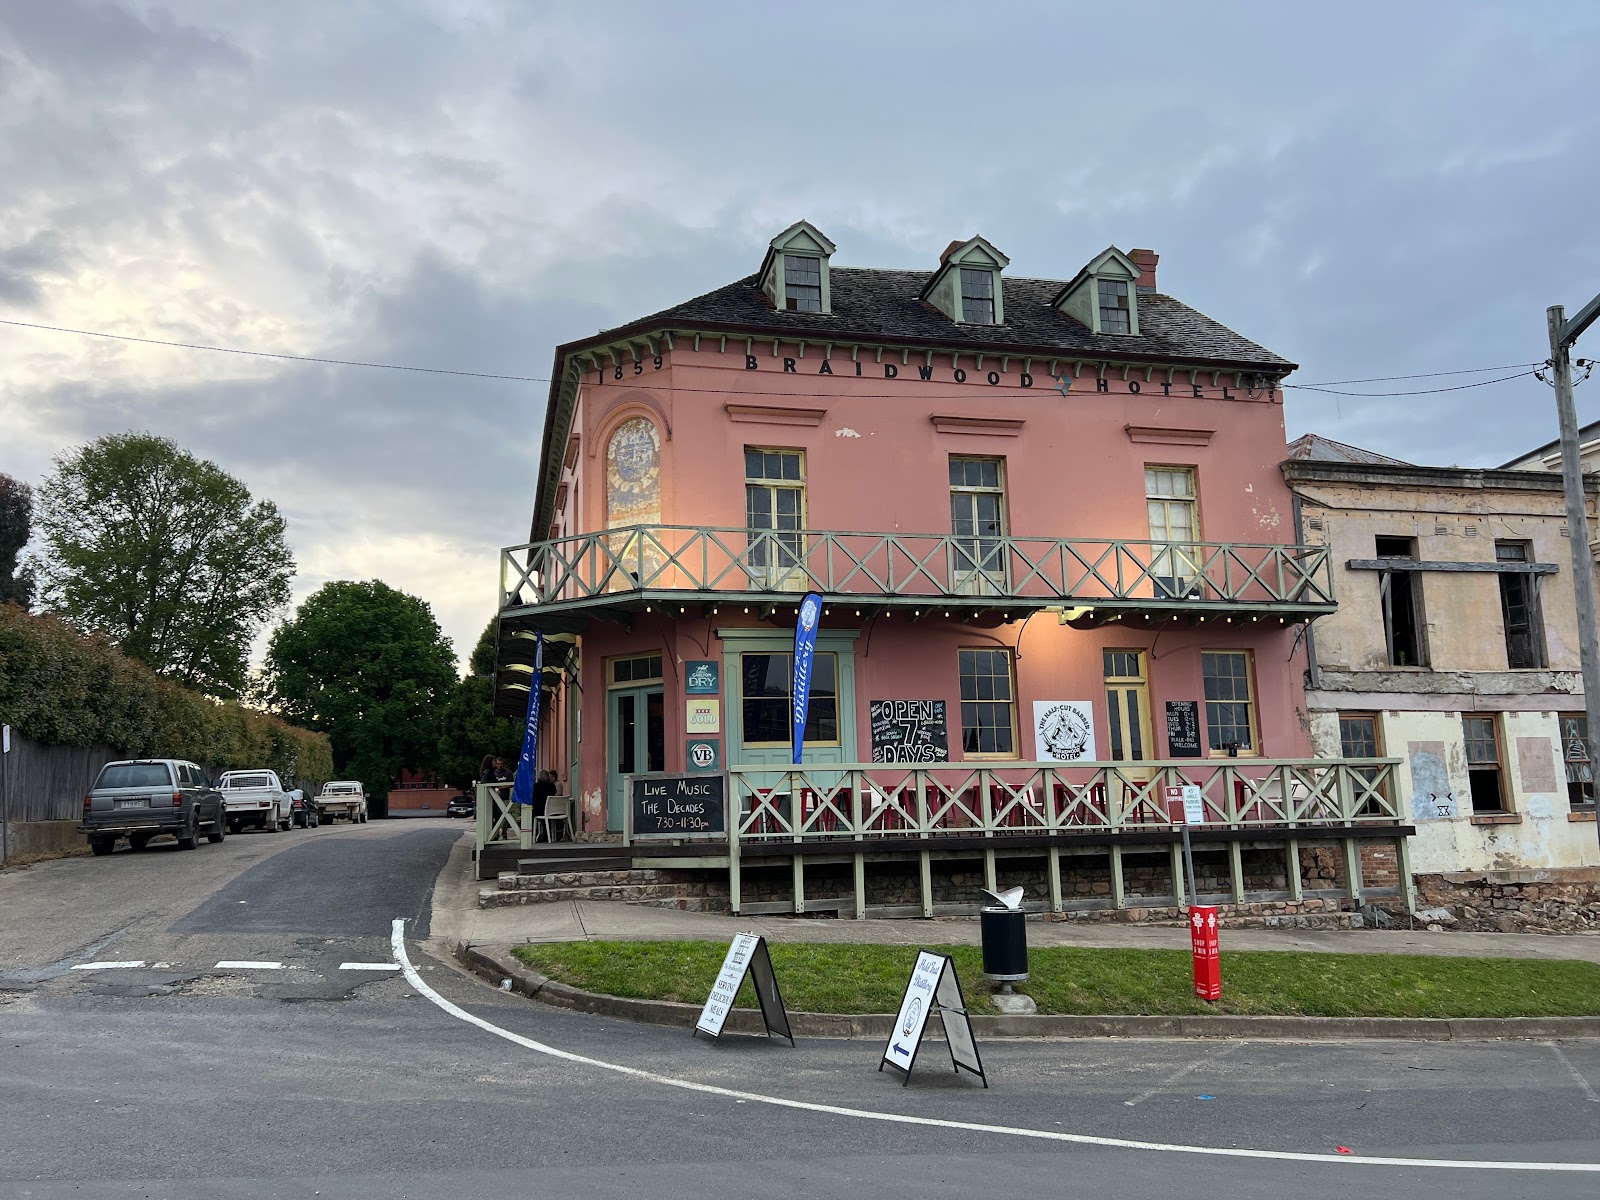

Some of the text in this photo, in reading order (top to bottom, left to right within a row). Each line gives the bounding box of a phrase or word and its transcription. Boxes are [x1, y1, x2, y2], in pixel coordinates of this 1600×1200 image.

[598, 356, 663, 385] 1859
[745, 355, 1235, 400] BRAIDWOOD HOTEL
[688, 678, 716, 687] DRY
[795, 640, 813, 724] Distillery
[690, 715, 717, 725] GOLD
[881, 701, 934, 720] OPEN
[1072, 708, 1090, 730] BARBER
[899, 718, 918, 746] 7
[693, 750, 712, 761] VB
[883, 744, 936, 763] DAYS
